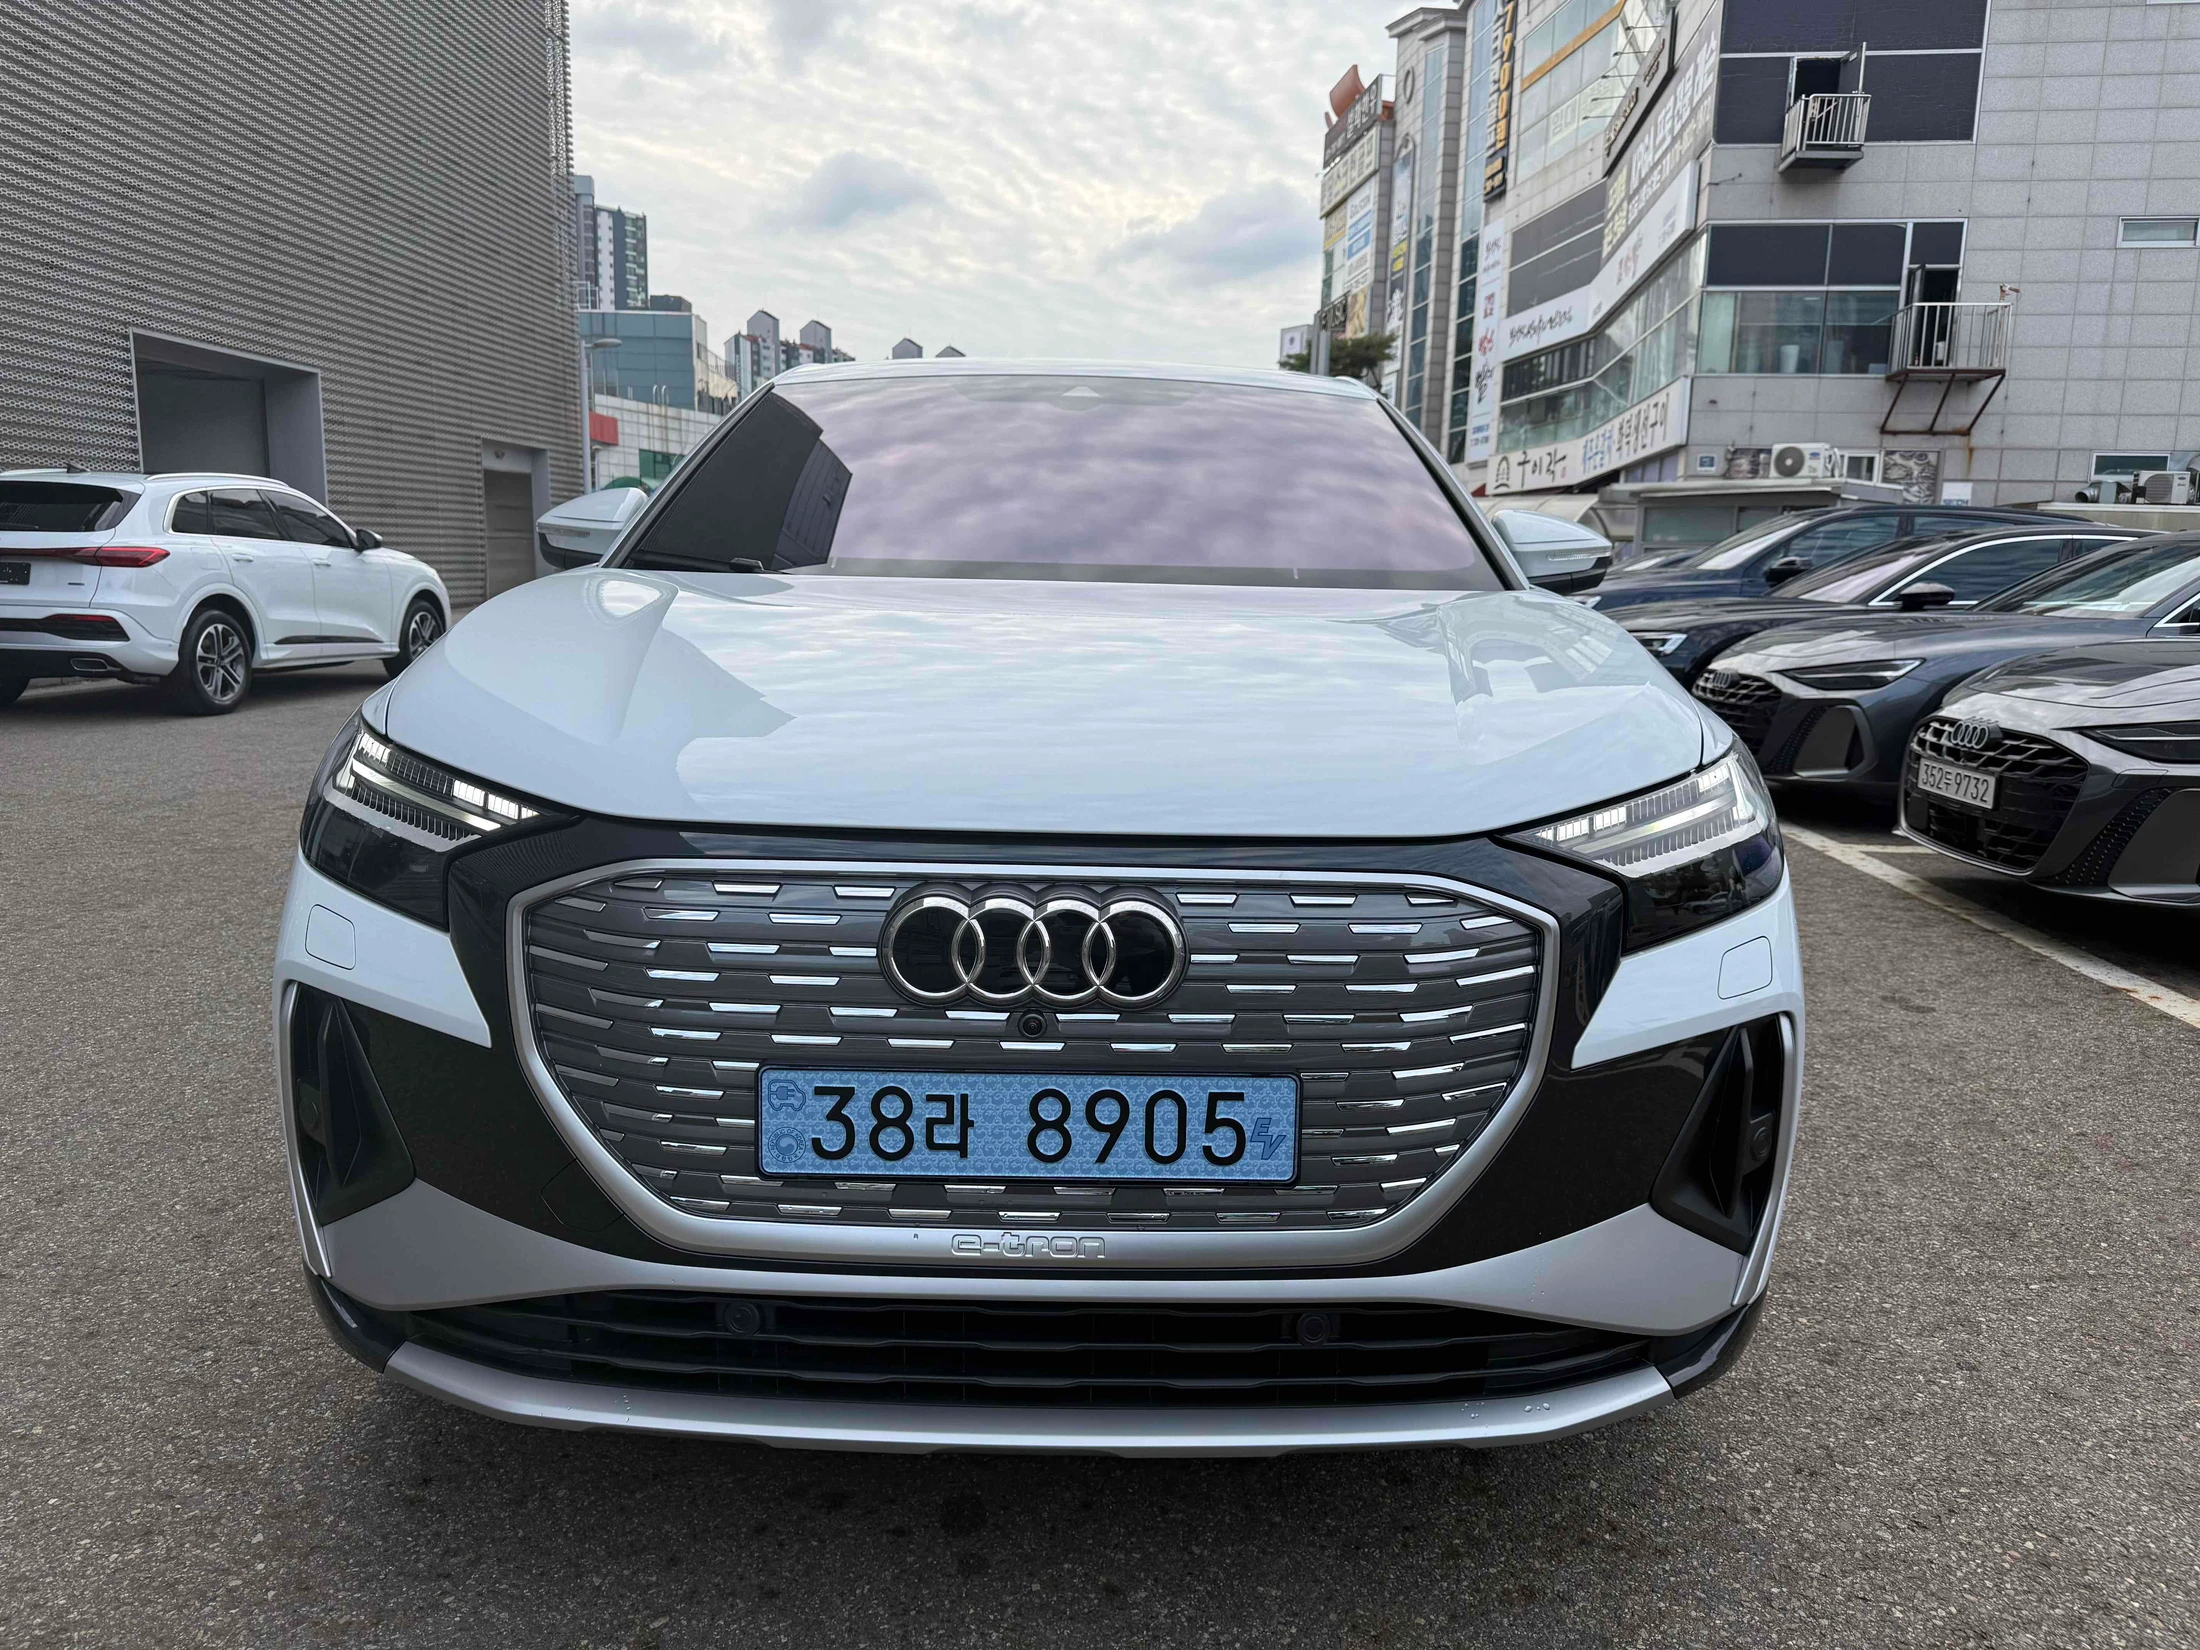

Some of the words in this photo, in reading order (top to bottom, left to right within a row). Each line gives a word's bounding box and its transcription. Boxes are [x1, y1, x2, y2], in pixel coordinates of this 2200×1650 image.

[811, 1085, 975, 1161] 38라
[1027, 1088, 1247, 1167] 8905
[1250, 1117, 1287, 1161] EV
[951, 1231, 1106, 1258] e-tron
